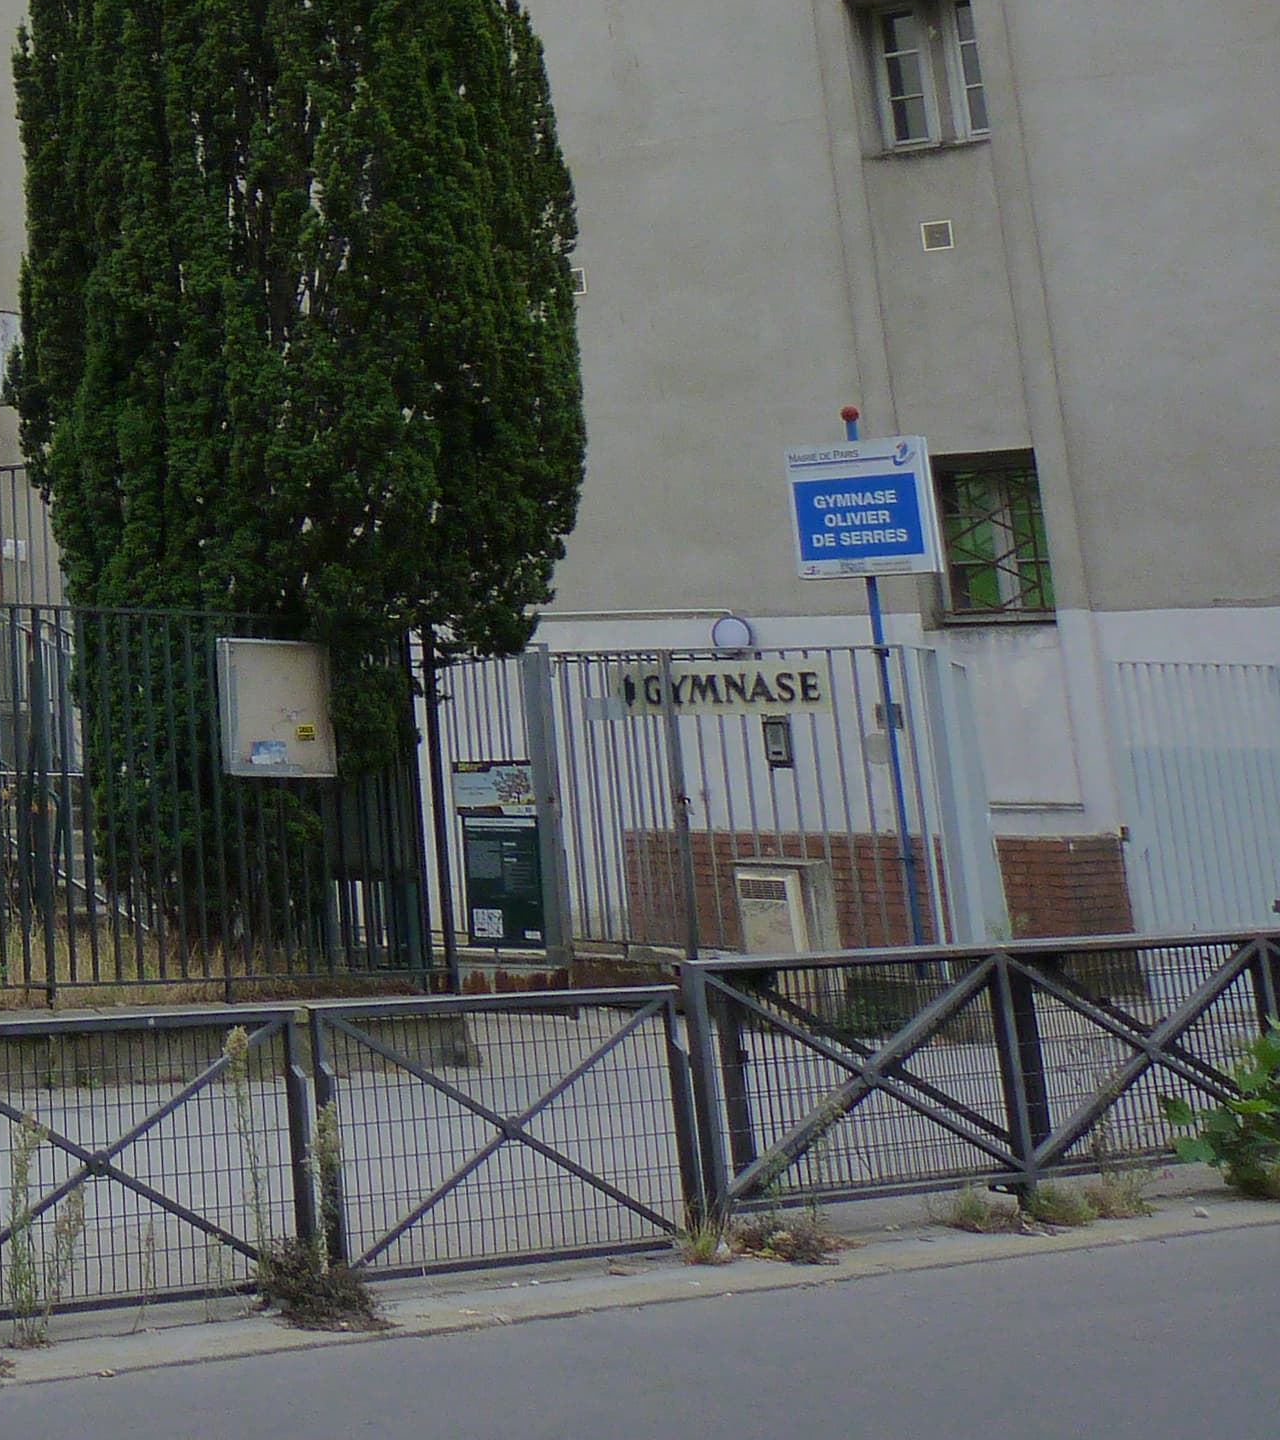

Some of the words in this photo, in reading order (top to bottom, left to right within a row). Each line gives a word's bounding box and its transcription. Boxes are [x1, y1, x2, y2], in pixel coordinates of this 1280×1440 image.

[813, 489, 897, 509] GYMNASE
[824, 510, 891, 528] OLIVIER
[811, 533, 836, 547] DE
[839, 528, 909, 546] SERRES
[644, 671, 821, 707] GYMNASE
